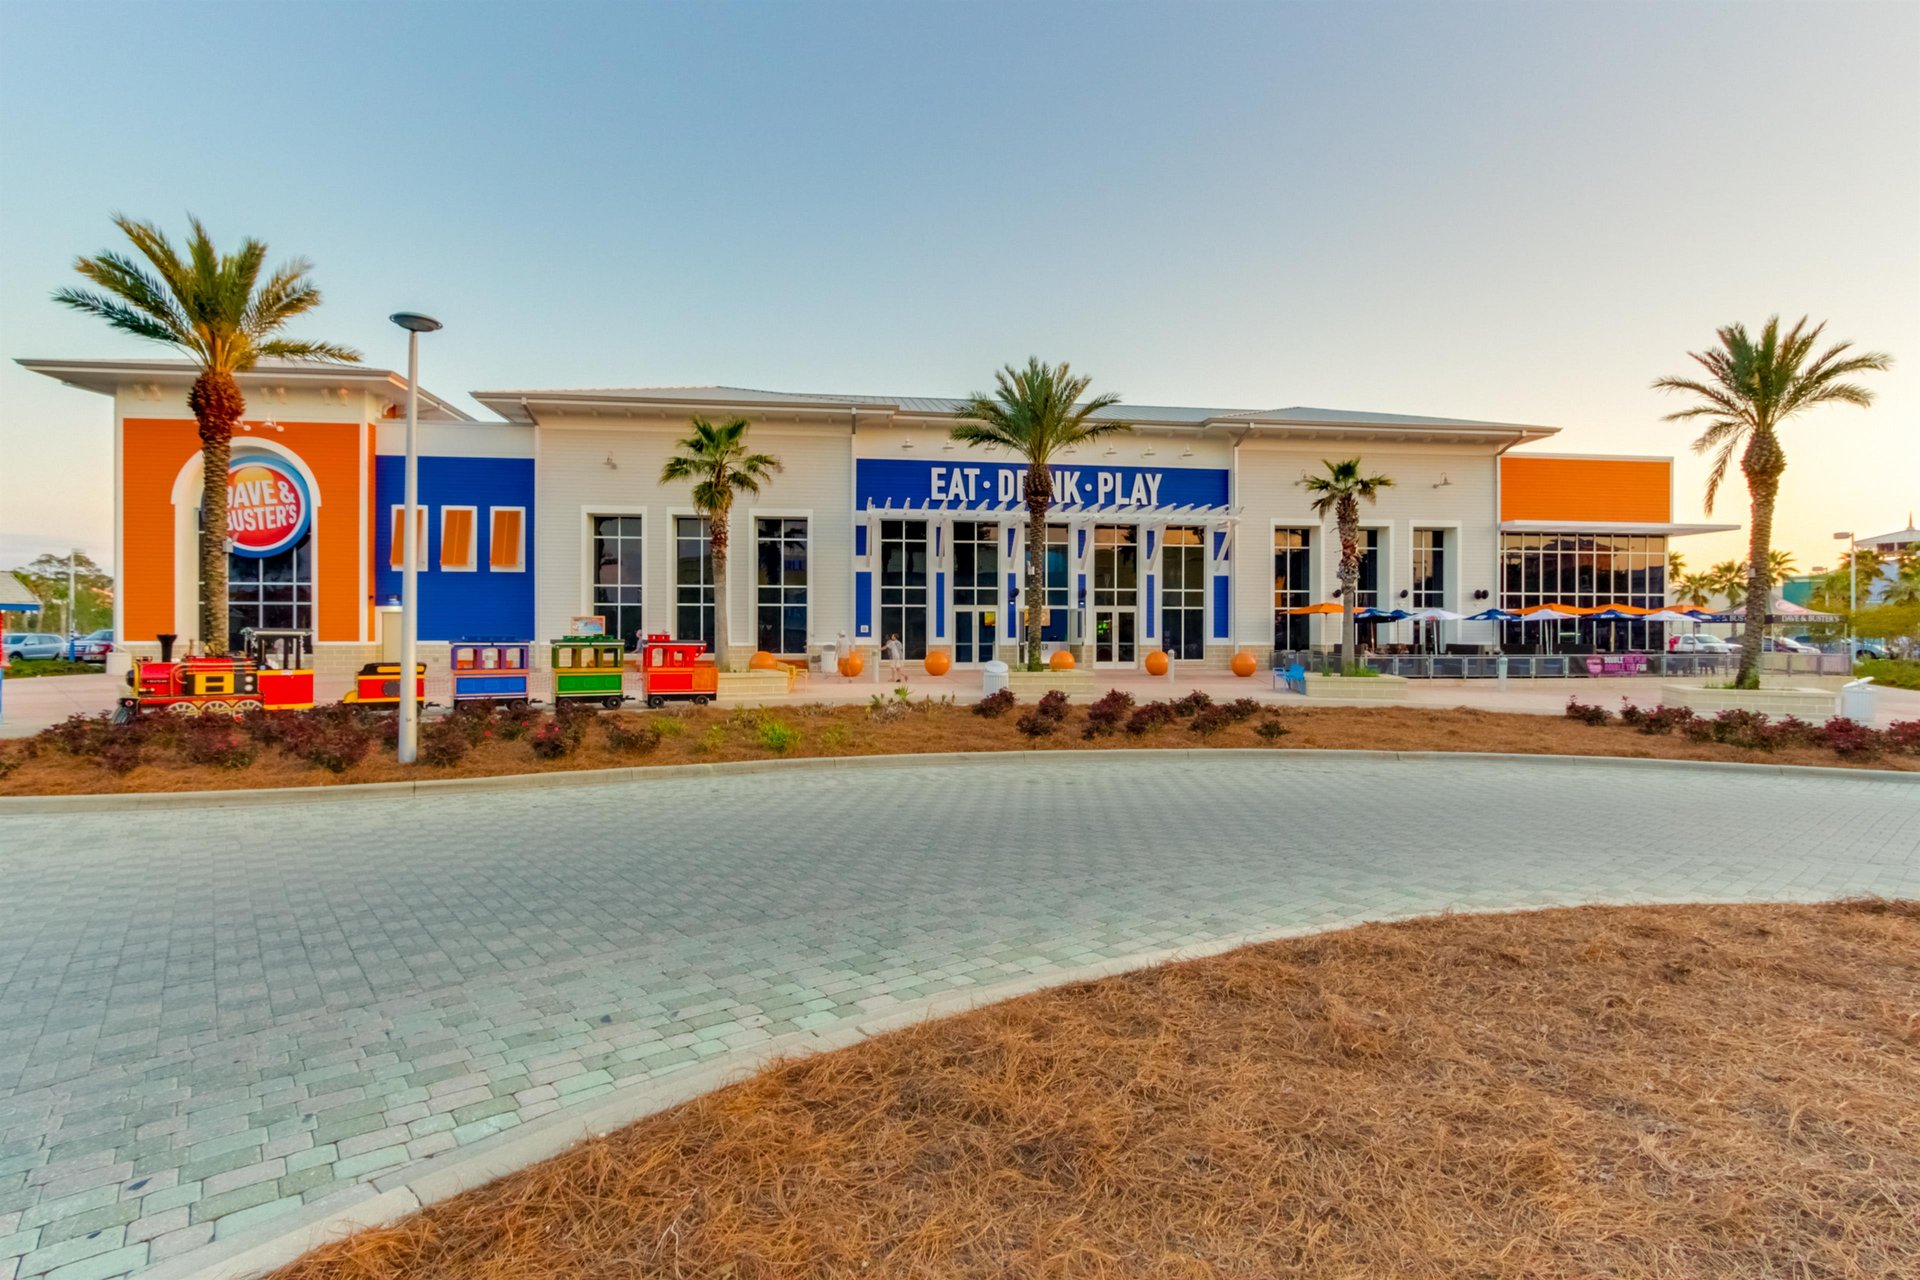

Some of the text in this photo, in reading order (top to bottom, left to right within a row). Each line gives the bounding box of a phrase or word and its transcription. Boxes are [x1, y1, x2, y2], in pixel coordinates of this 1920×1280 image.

[278, 481, 295, 503] &
[931, 467, 1162, 505] EAT DRNK PLAY
